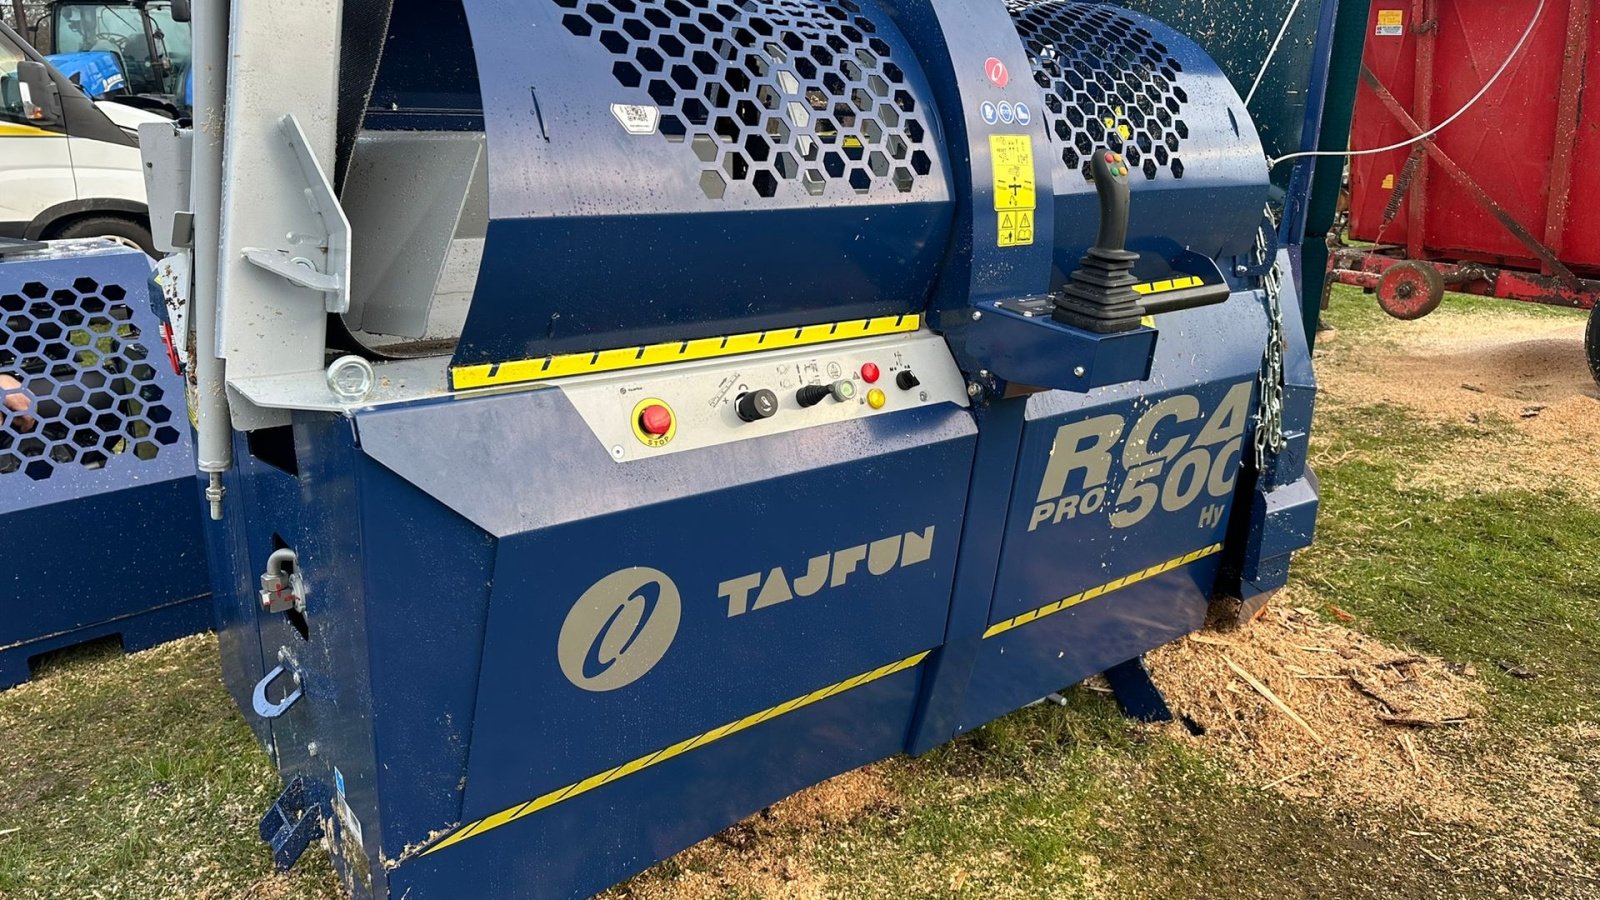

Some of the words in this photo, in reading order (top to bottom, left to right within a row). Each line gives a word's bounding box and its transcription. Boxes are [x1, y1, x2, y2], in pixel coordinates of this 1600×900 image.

[648, 436, 669, 447] STOP
[1027, 487, 1106, 532] PRO
[1109, 437, 1242, 528] 500
[1036, 381, 1253, 503] RCA
[1198, 503, 1224, 529] Hy
[717, 525, 935, 618] TAJFUN
